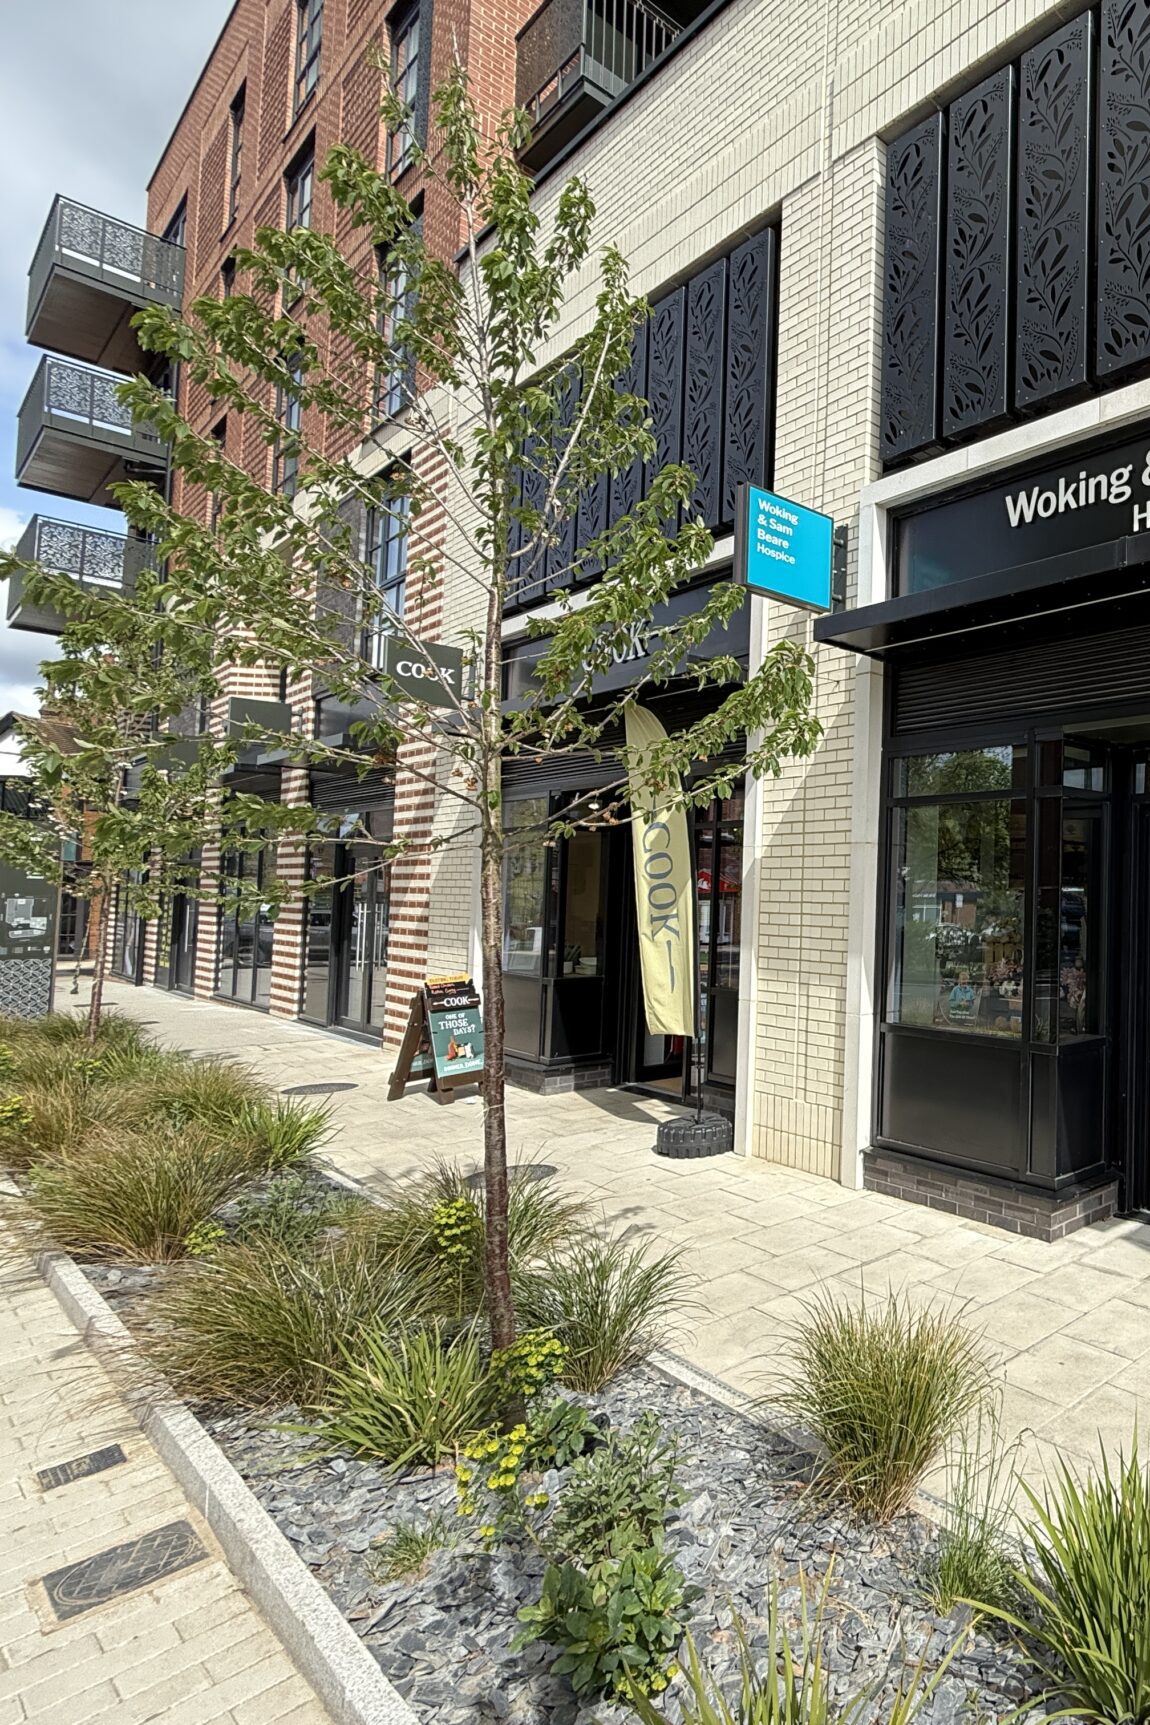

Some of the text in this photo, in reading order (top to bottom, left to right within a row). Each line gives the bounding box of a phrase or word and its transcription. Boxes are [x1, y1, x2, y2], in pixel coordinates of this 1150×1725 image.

[1005, 463, 1133, 527] Woking
[758, 498, 799, 526] Woking
[757, 514, 793, 537] & Sam
[757, 528, 790, 549] Beare
[757, 542, 796, 565] Hospice
[642, 821, 680, 943] COOK
[443, 996, 470, 1007] COOK
[438, 1019, 468, 1030] THOSE
[453, 1024, 475, 1036] DAYS?
